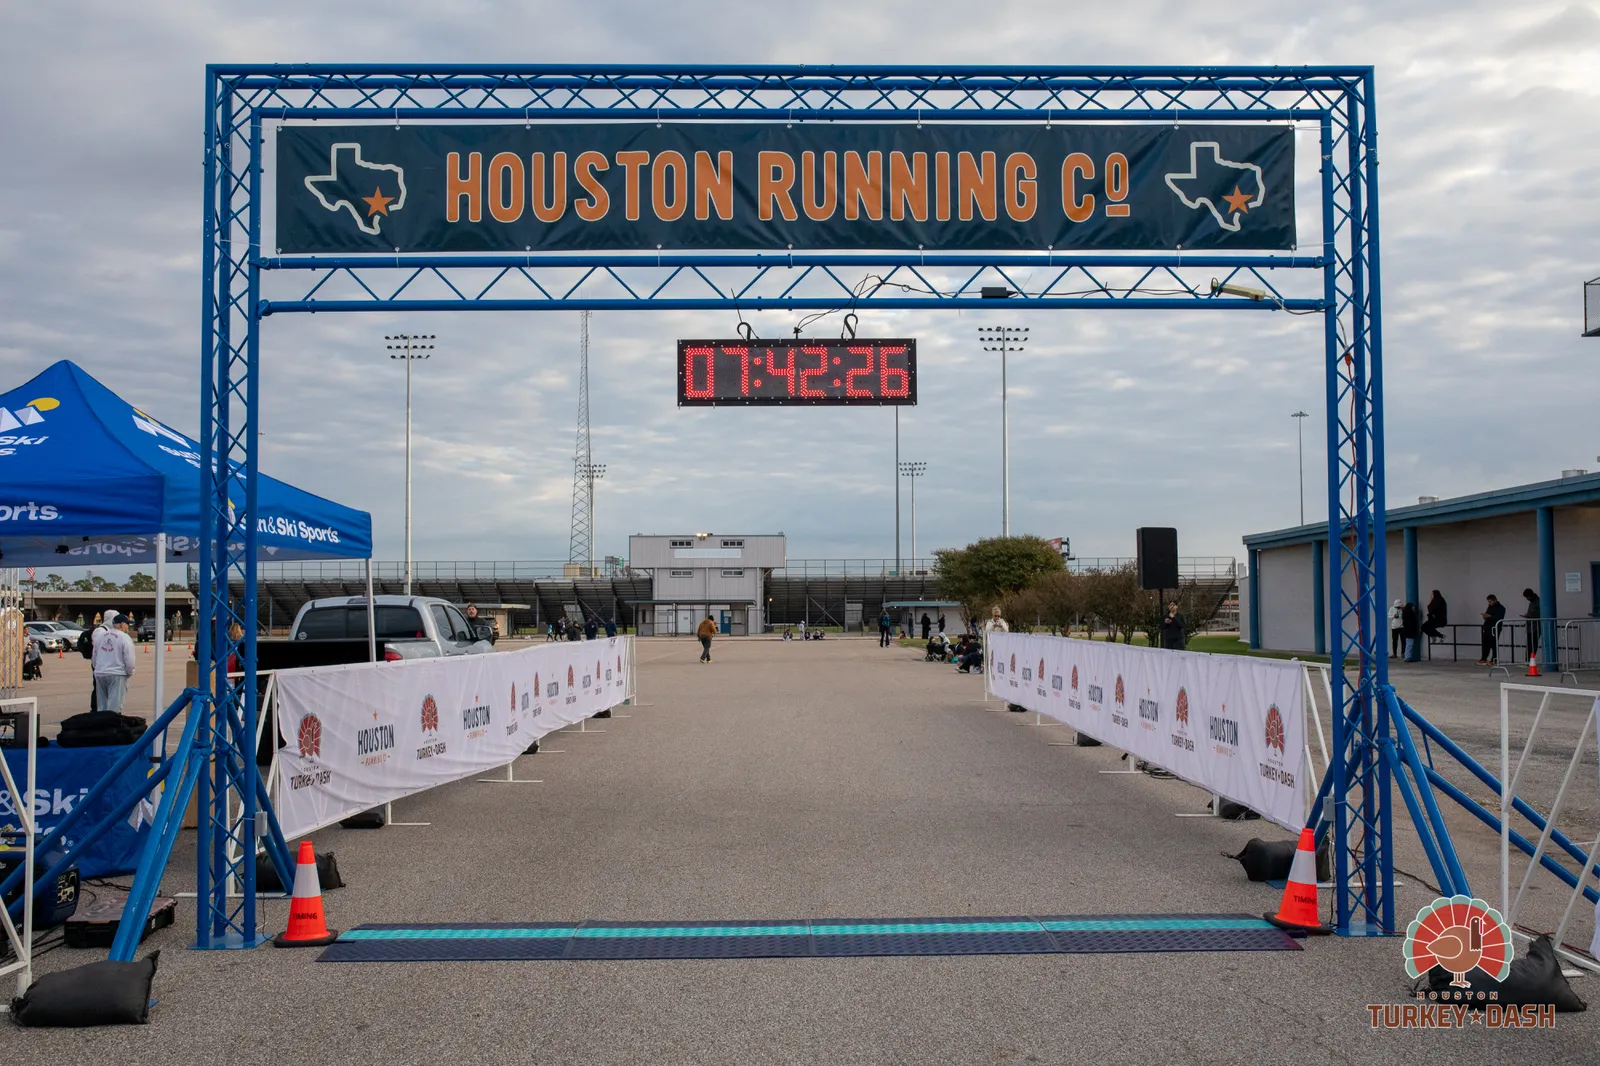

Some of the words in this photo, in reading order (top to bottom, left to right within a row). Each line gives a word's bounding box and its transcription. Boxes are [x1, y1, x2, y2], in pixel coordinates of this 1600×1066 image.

[446, 150, 734, 222] HOUSTON
[757, 150, 1038, 222] RUNNING
[685, 346, 908, 398] 07:42:26
[463, 705, 490, 730] HOUSTON
[1209, 715, 1239, 747] HOUSTON
[358, 724, 394, 756] HOUSTON
[416, 746, 434, 760] TURKEY
[1260, 763, 1278, 782] TURKEY
[1281, 770, 1295, 788] DASH
